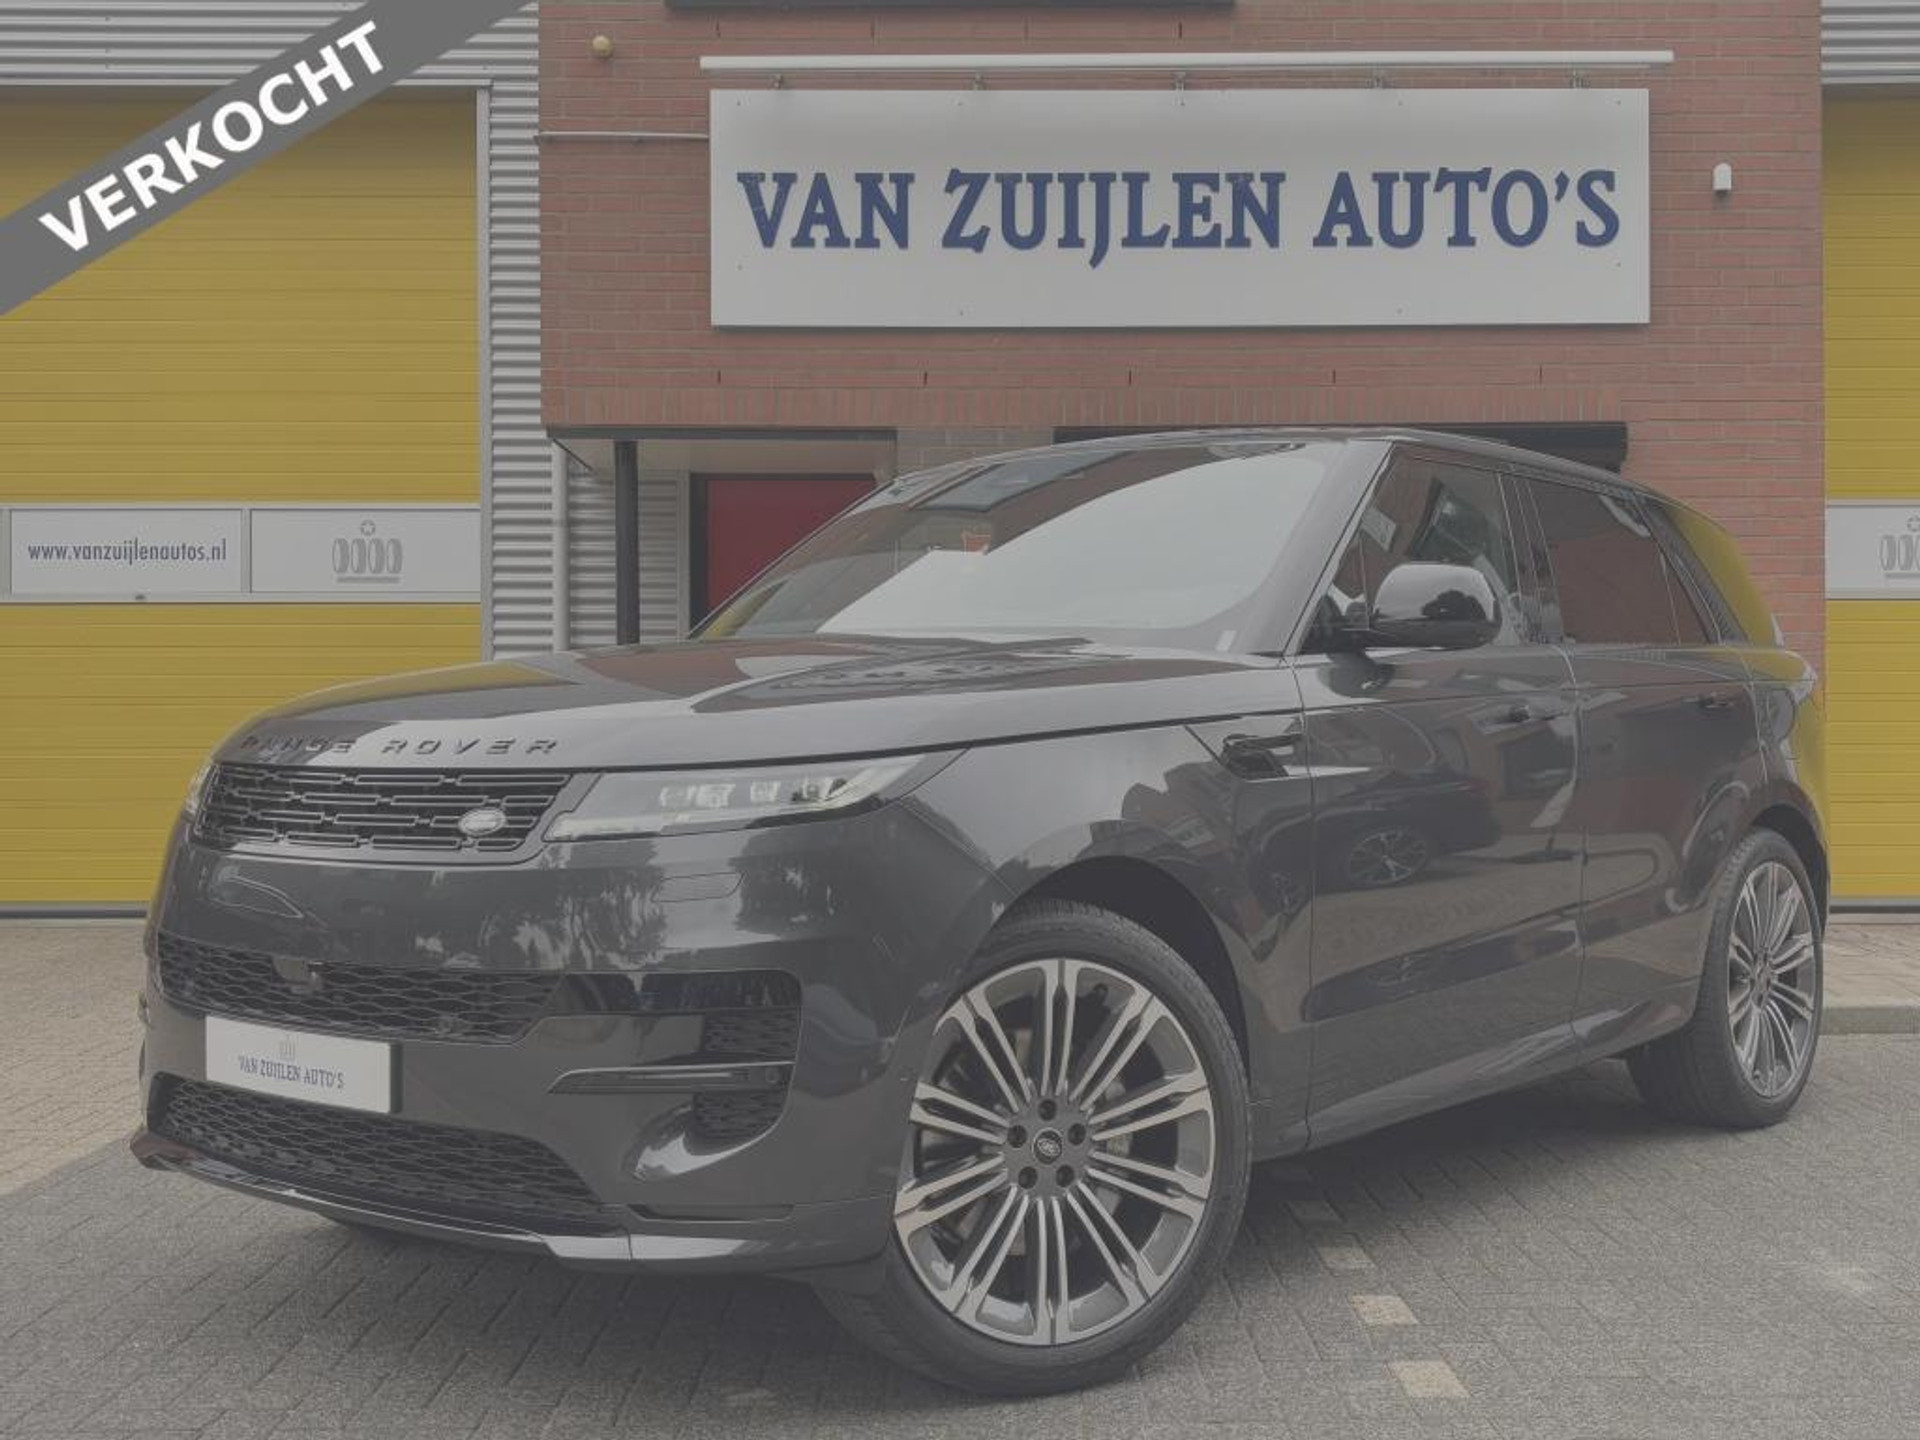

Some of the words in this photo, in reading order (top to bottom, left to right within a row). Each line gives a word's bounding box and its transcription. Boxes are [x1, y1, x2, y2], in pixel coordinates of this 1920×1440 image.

[738, 171, 915, 250] VAN
[942, 168, 1286, 269] ZUIJLEN
[1312, 167, 1620, 249] AUTO'S
[28, 538, 227, 565] www.vanzuijlenautos.nl
[381, 738, 559, 756] ROVER
[238, 1055, 258, 1075] VAN
